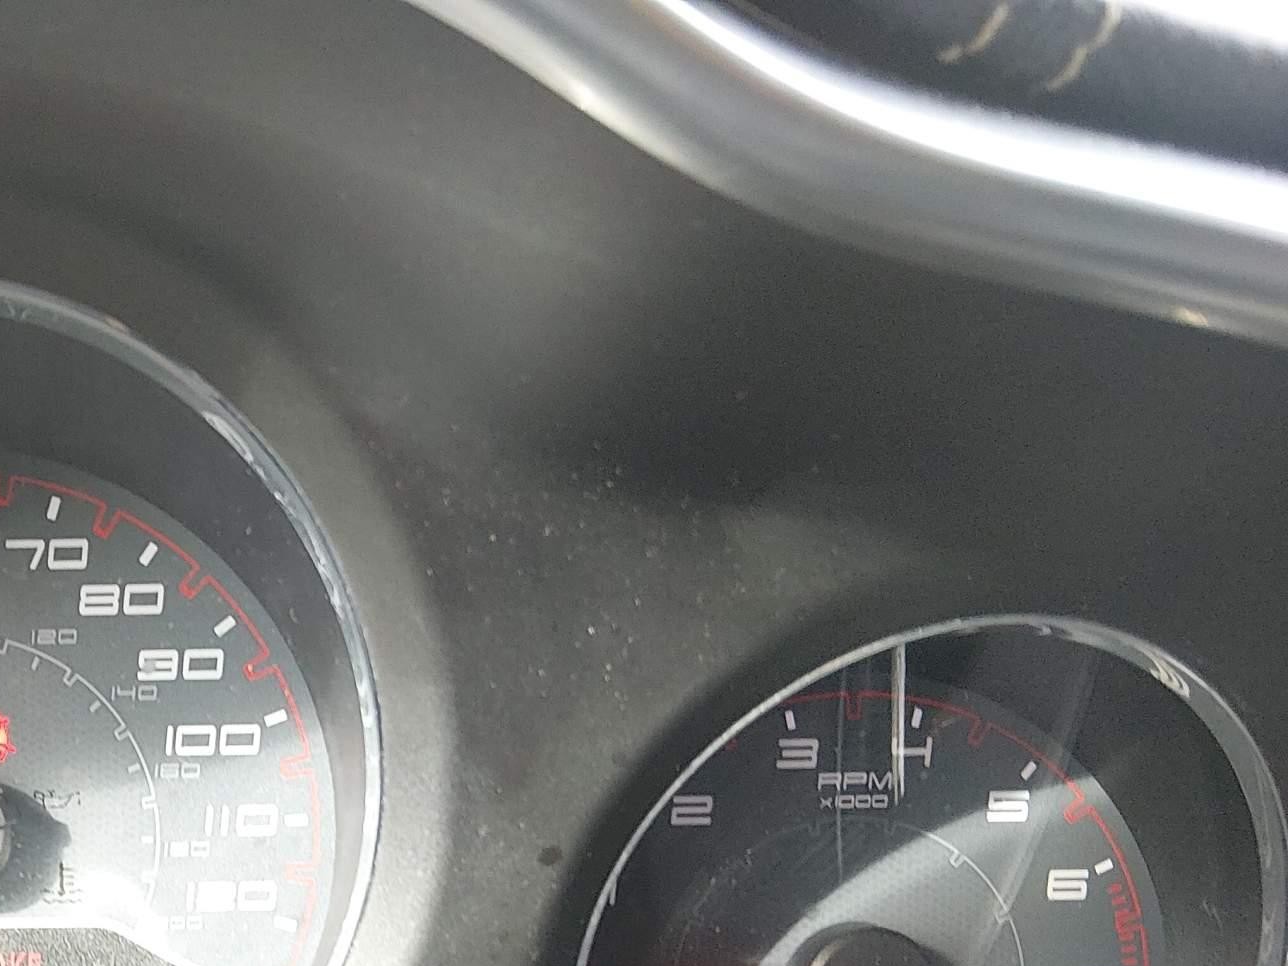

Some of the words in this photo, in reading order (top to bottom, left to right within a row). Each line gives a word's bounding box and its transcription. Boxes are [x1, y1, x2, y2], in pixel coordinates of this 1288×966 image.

[5, 537, 89, 571] 70
[79, 583, 165, 616] 80
[136, 648, 225, 681] 90
[110, 684, 158, 702] 140
[165, 723, 262, 757] 100
[776, 738, 819, 770] 3
[817, 770, 893, 792] RPM
[204, 803, 280, 838] 110
[670, 794, 713, 826] 2
[985, 789, 1031, 823] 5
[186, 879, 278, 913] 10
[1046, 868, 1090, 901] 6
